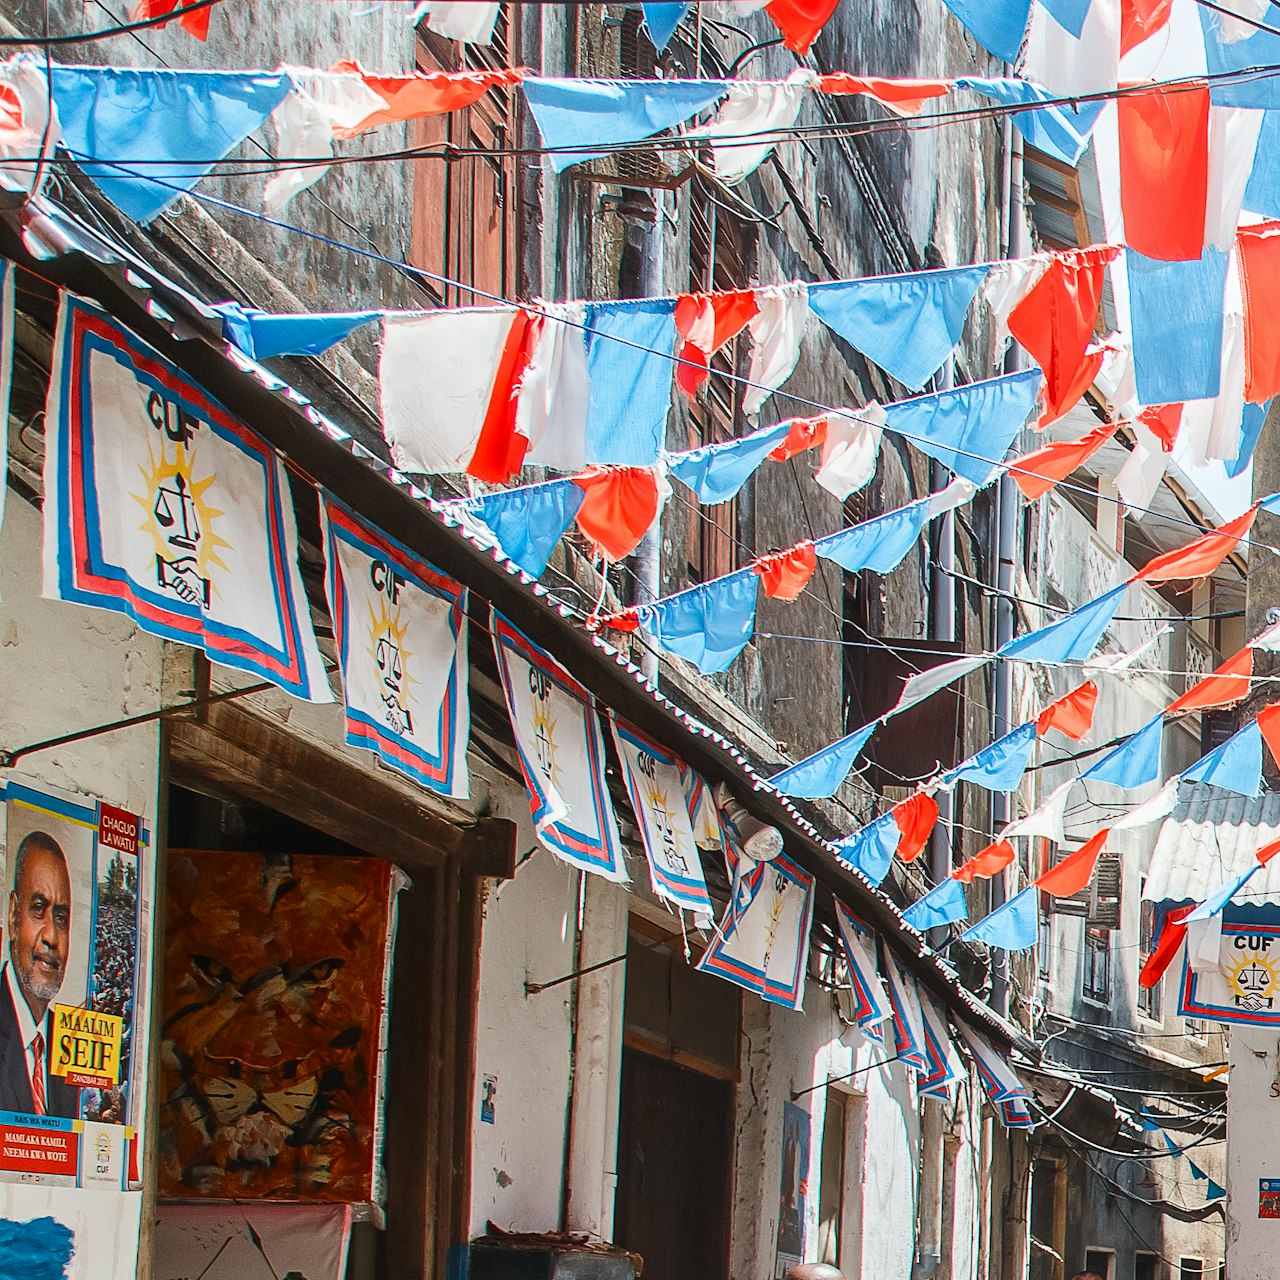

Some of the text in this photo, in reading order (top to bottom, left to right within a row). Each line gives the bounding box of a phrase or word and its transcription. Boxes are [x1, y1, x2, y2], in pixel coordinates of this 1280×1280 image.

[148, 391, 201, 451] CUF
[370, 560, 406, 606] CUF
[529, 666, 552, 702] CUF
[102, 815, 137, 837] CHAGUO
[102, 831, 136, 852] LA WATU
[1234, 935, 1275, 951] CUF
[61, 1012, 116, 1038] MAALIM
[59, 1034, 114, 1071] SEIF
[14, 1115, 60, 1128] RAIS WA WATU
[5, 1132, 40, 1146] MAMLAKA
[3, 1147, 68, 1163] NEEMA KWA WOTE
[96, 1165, 110, 1174] CUF
